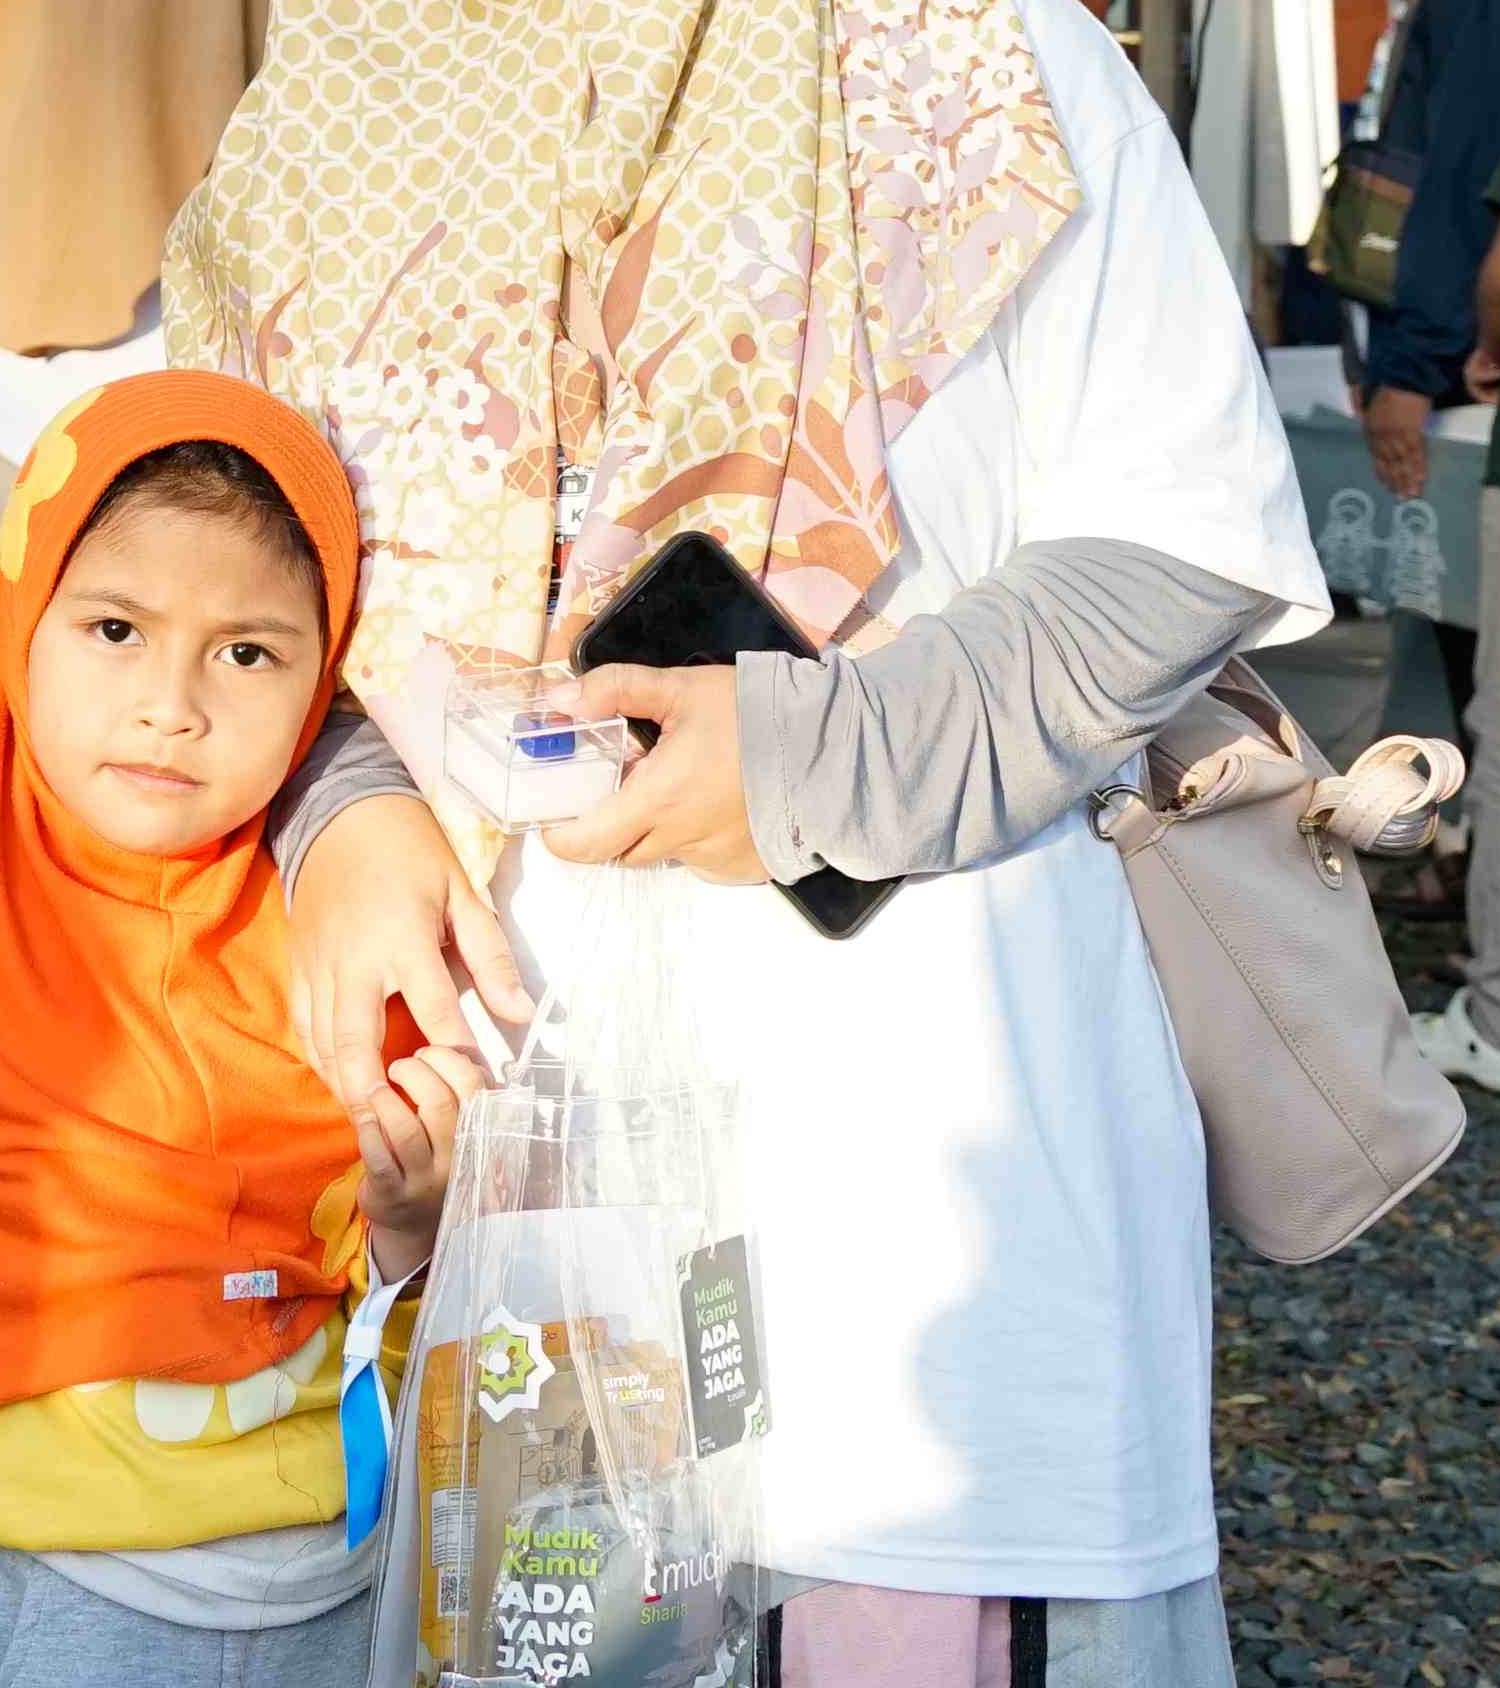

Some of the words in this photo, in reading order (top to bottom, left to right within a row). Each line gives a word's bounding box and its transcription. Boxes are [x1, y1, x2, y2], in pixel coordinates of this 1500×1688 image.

[694, 1277, 735, 1308] Mudik
[695, 1298, 738, 1328] Kamu
[700, 1318, 741, 1354] ADA
[701, 1345, 743, 1376] YANG
[704, 1368, 745, 1400] JAGA
[504, 1525, 600, 1551] Mudik
[503, 1548, 598, 1579] Kamu
[498, 1580, 597, 1614] ADA
[640, 1602, 689, 1626] Sharia
[498, 1616, 594, 1646] YANG
[496, 1643, 593, 1682] JAGA
